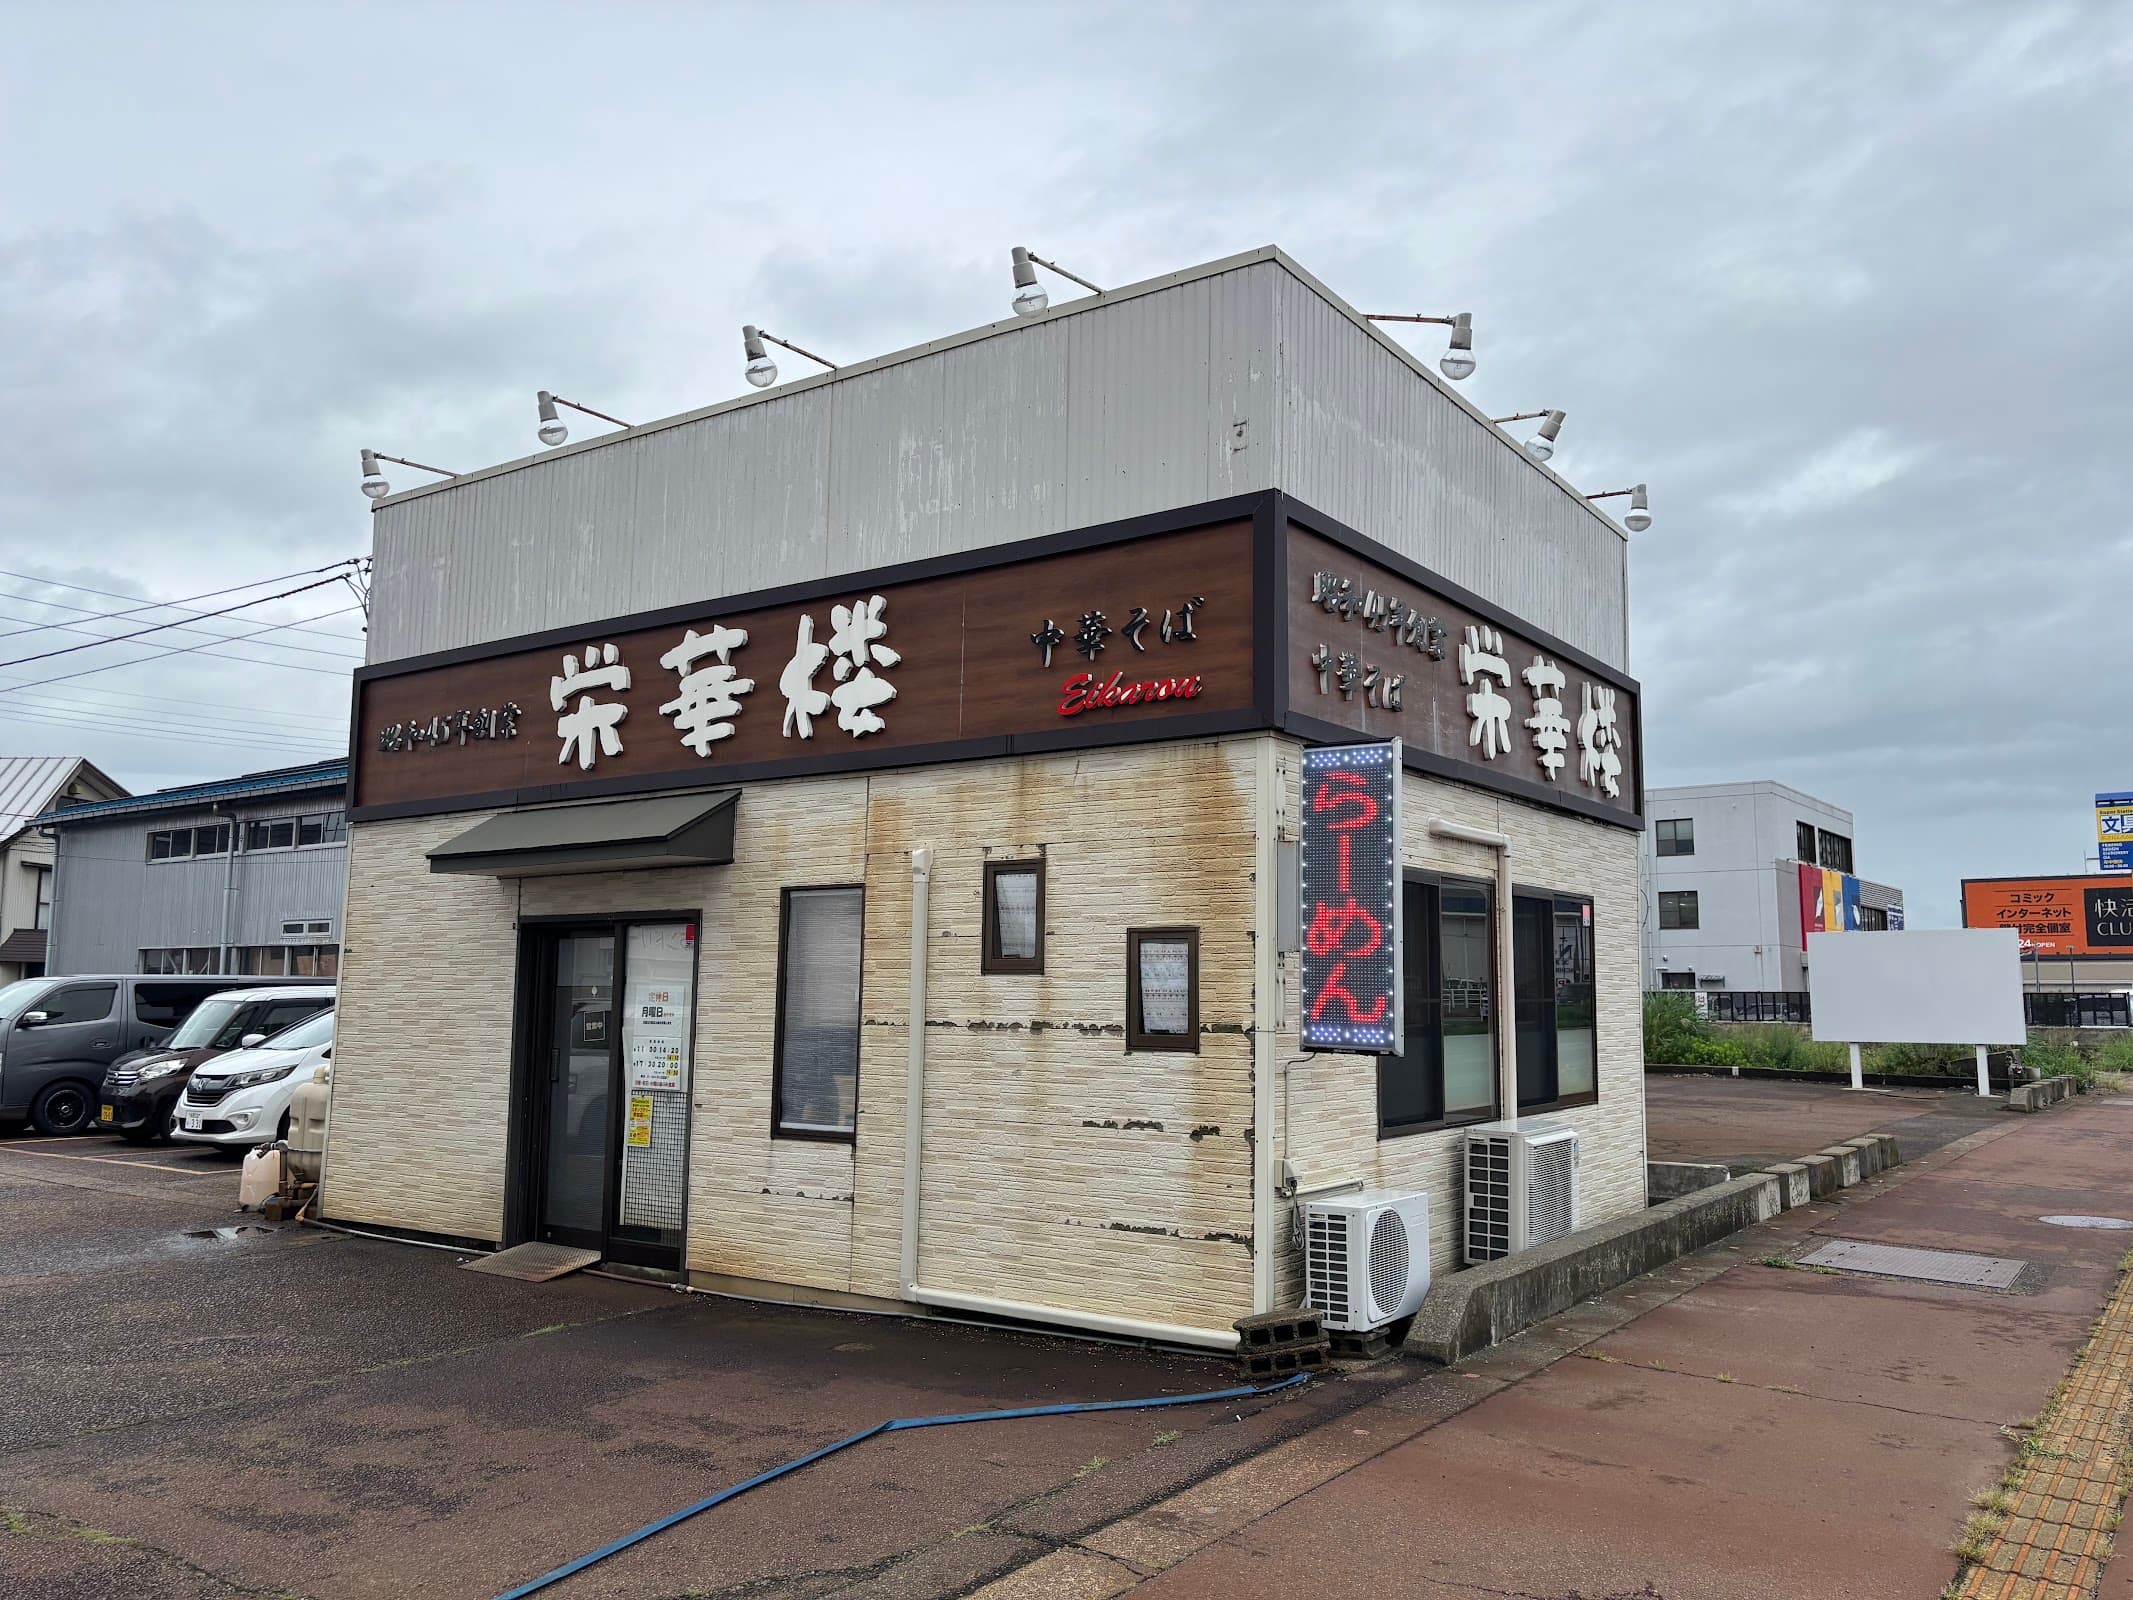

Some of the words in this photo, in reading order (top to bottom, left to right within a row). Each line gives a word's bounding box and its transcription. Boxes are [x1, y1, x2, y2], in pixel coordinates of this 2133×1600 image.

[1030, 596, 1205, 668] 中華そば
[550, 594, 901, 770] 栄華楼
[1312, 643, 1407, 712] 中華そば
[1458, 625, 1622, 799] 栄華楼
[1306, 770, 1385, 1023] らーめん
[1997, 907, 2071, 919] インターネット
[2010, 892, 2055, 903] コミック
[642, 1006, 663, 1017] 月曜日
